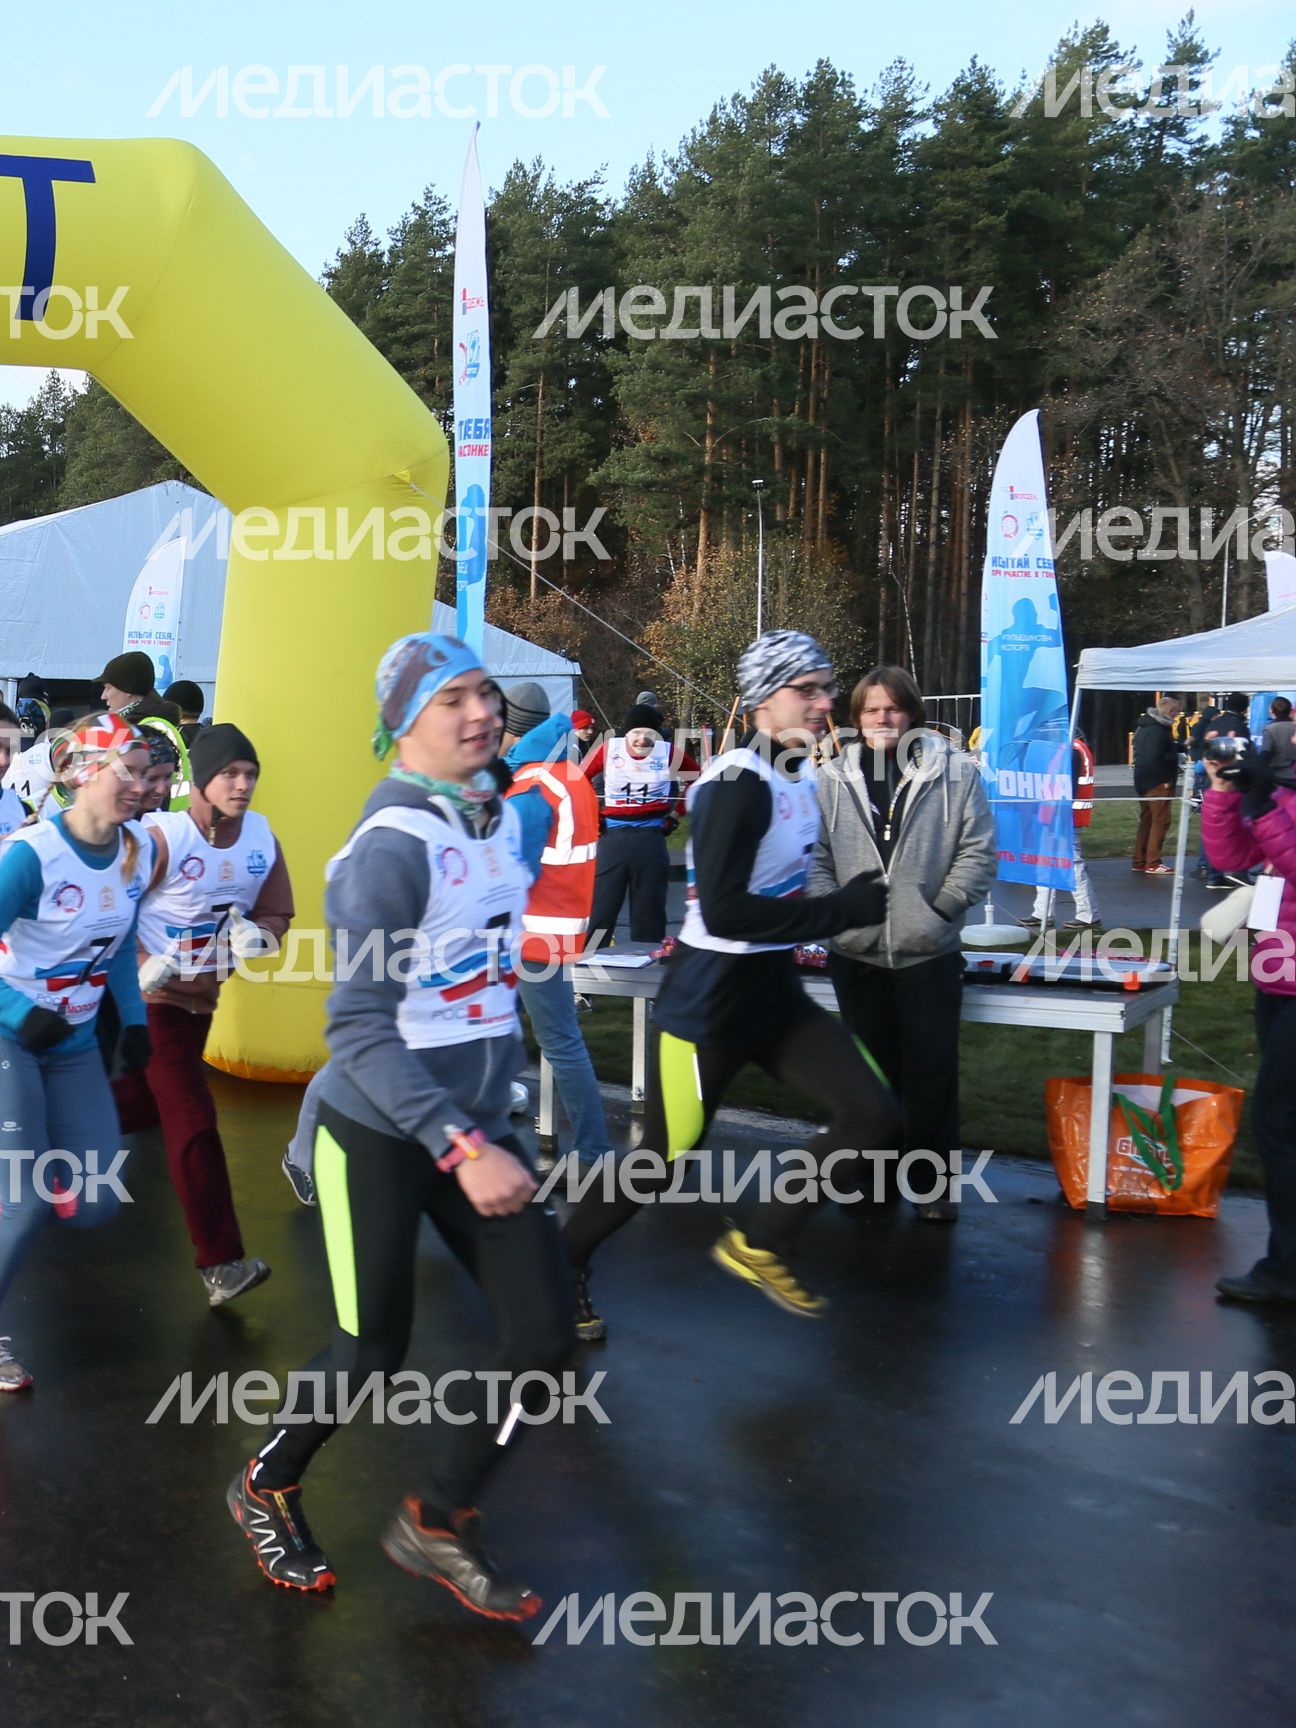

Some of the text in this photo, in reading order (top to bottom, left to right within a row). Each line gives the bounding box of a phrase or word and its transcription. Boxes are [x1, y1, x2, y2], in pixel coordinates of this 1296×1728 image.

[621, 783, 649, 805] 11
[996, 769, 1073, 801] ОНКА
[80, 936, 117, 985] 7
